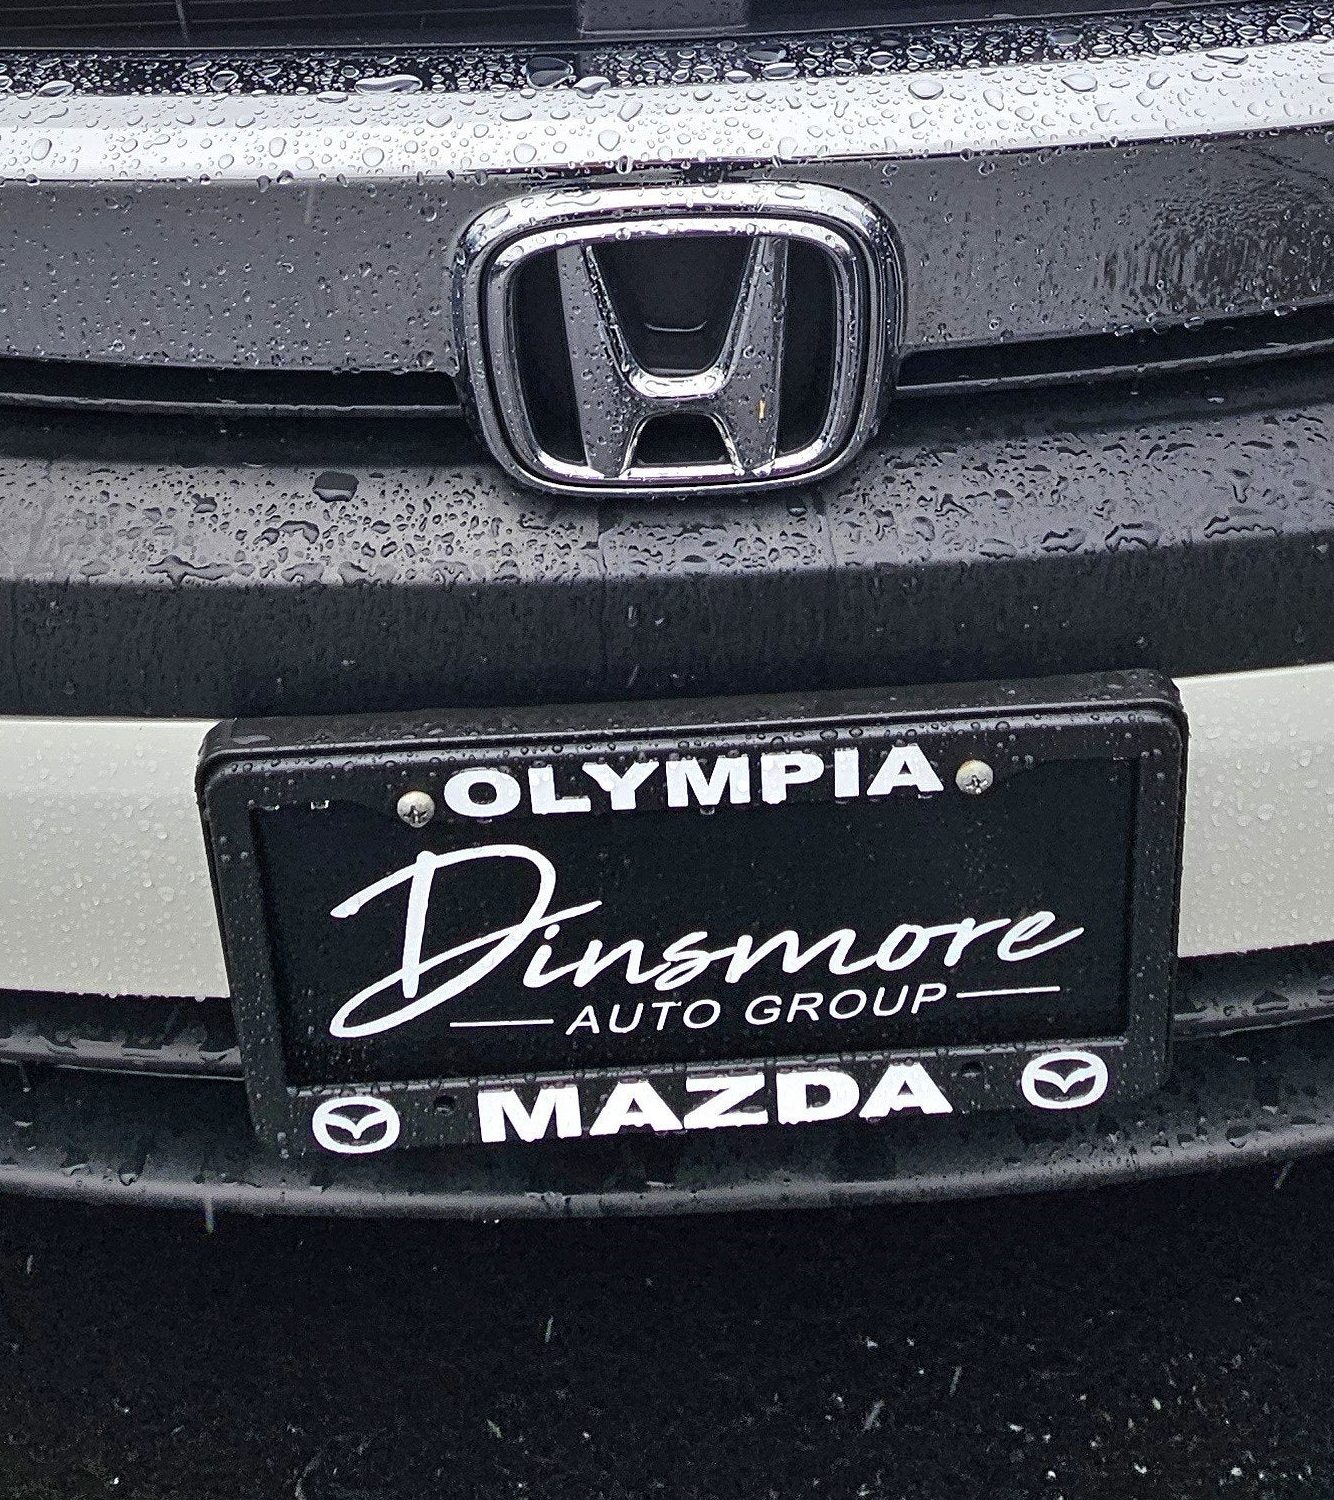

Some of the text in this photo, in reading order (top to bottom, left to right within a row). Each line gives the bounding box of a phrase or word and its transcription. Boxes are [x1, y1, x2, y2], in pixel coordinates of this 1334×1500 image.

[444, 743, 943, 818] OLYMPIA
[329, 844, 1085, 1038] Dinsmore
[566, 983, 948, 1036] AUTO GROUP
[476, 1062, 954, 1143] MAZDA
